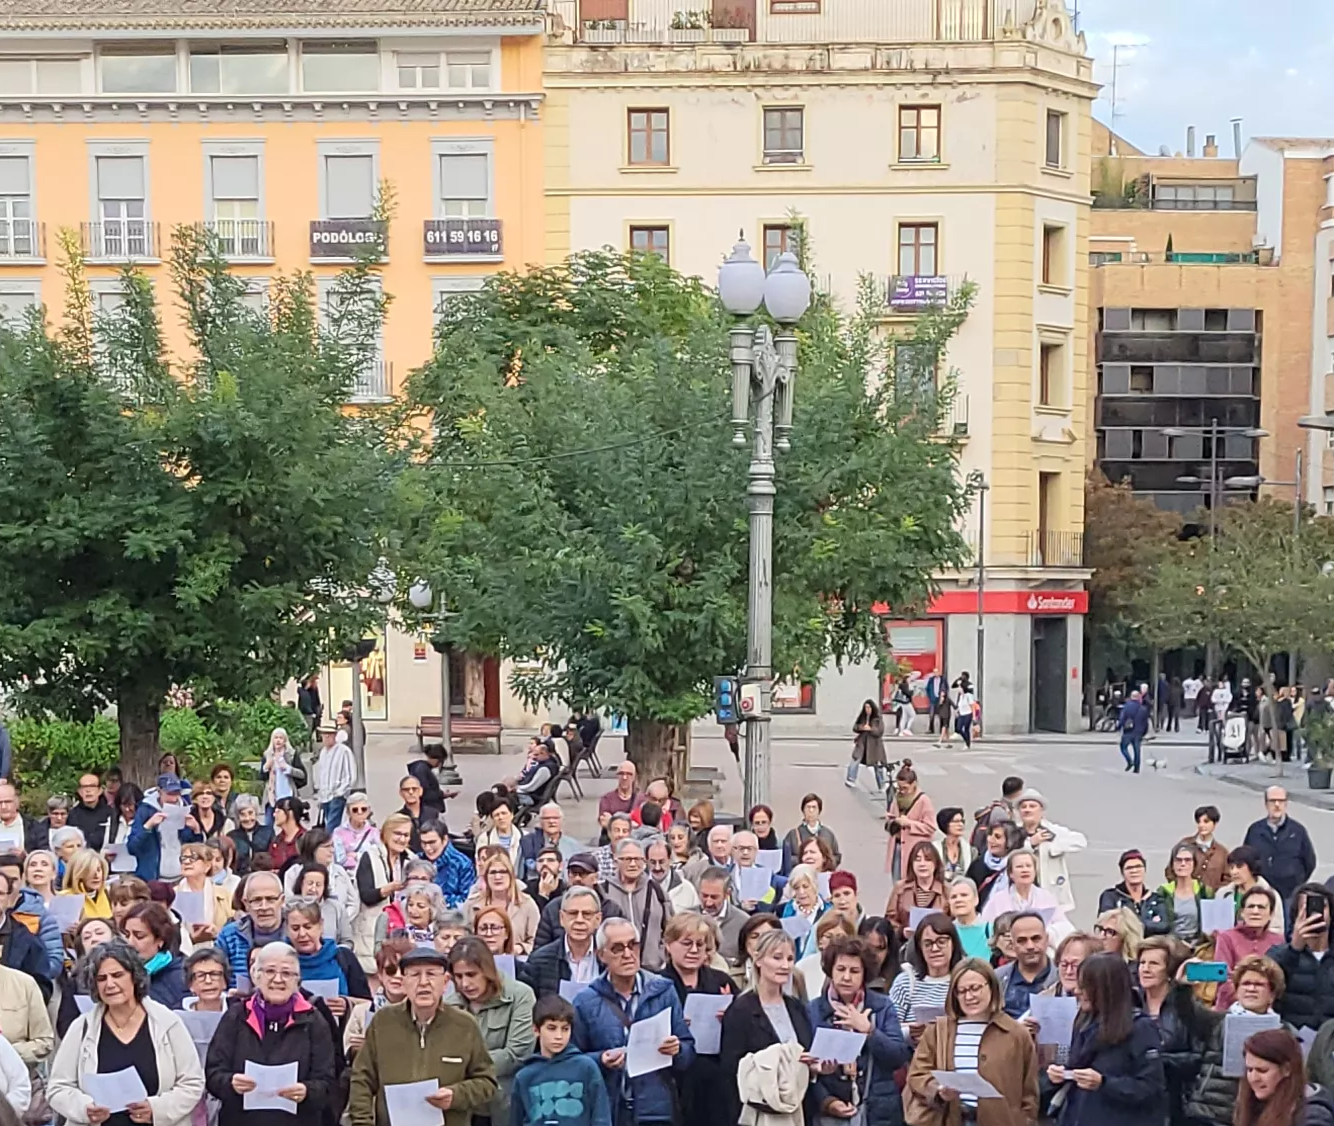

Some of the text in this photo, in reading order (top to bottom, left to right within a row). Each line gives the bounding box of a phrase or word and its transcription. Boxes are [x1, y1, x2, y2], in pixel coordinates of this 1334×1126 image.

[427, 230, 498, 243] 611 59 16 16
[1038, 595, 1075, 609] Santander
